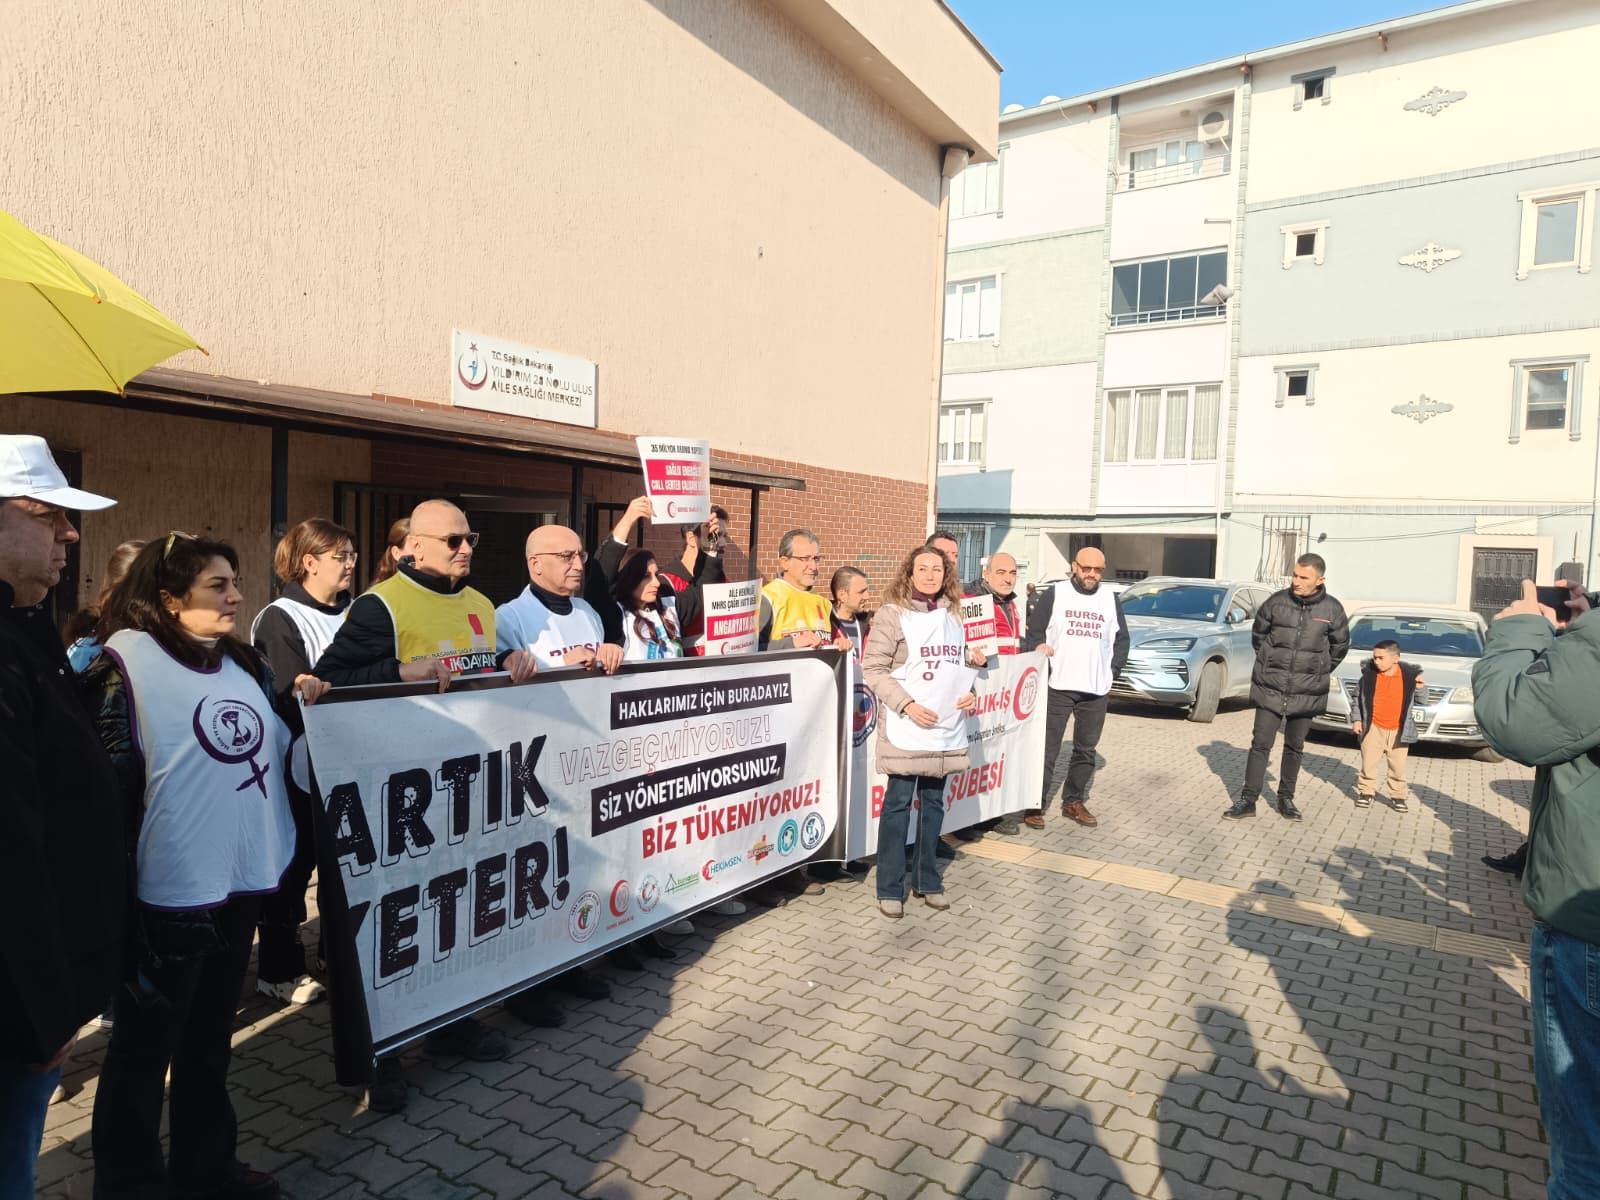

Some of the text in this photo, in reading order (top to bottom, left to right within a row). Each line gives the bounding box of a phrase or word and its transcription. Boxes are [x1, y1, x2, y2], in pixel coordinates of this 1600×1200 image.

[491, 365, 532, 383] YILDIRIM
[571, 381, 593, 396] ULUS
[491, 380, 582, 407] AİLE SAĞLIĞI MERKEZİ
[1064, 609, 1105, 623] BURSA
[1068, 620, 1102, 630] TABİP
[920, 644, 962, 658] BURSA
[1066, 628, 1103, 640] ODASI
[618, 682, 790, 721] HAKLARIMIZ İÇİN BURADAYIZ
[560, 714, 771, 785] VAZGEÇMİYORUZ!
[599, 755, 782, 822] SİZ YÖNETEMİYORSUNUZ,
[946, 753, 1006, 812] ŞUBESİ
[325, 734, 549, 877] ARTIK
[643, 815, 678, 859] BİZ
[682, 780, 821, 845] TÜKENİYORUZ!
